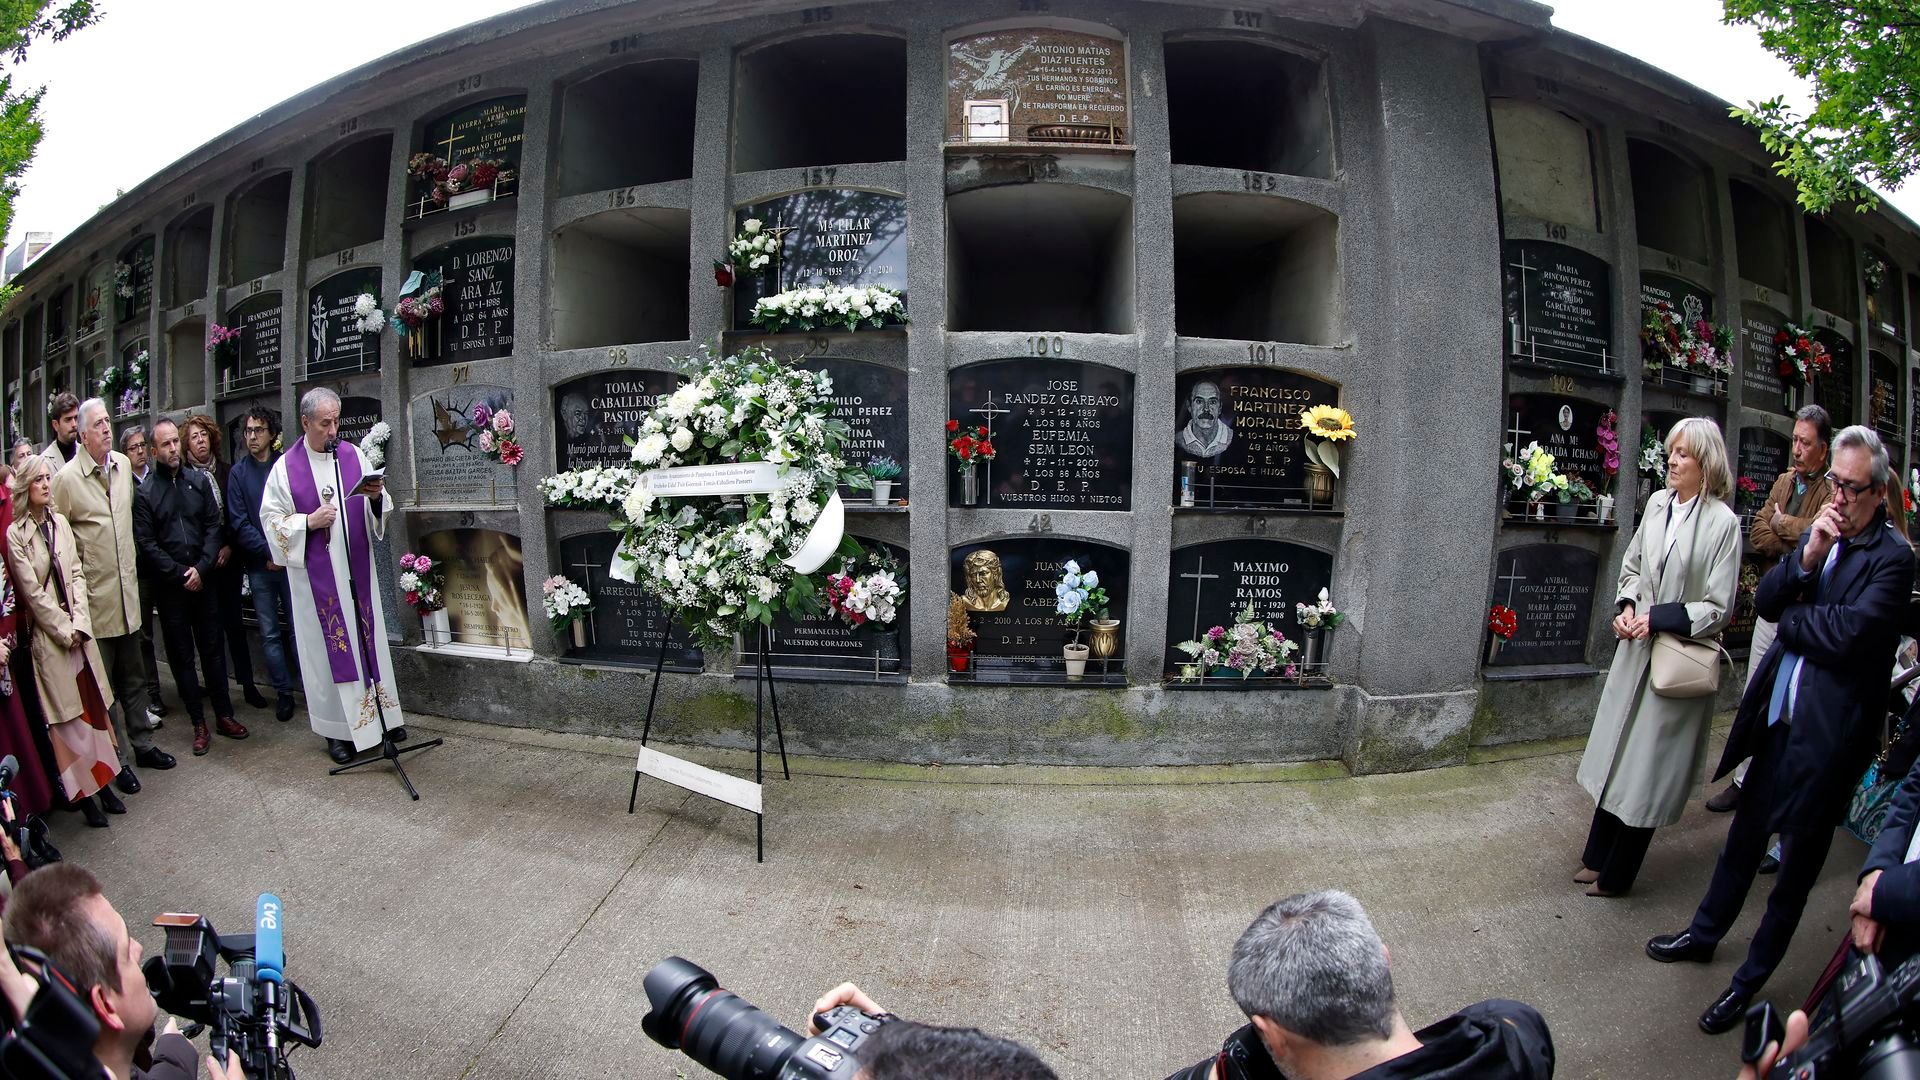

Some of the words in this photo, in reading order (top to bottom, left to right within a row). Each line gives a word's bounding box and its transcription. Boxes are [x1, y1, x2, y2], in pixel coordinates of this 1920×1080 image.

[1035, 45, 1075, 54] ANTONIO
[1077, 46, 1111, 55] MATIAS
[1041, 56, 1062, 64] DIAZ
[1064, 57, 1105, 66] FUENTES
[1042, 75, 1078, 83] HERMANOS
[483, 105, 505, 115] MARIA
[1090, 104, 1125, 112] RECUERDO
[480, 131, 502, 142] LUCIO
[802, 168, 837, 186] 157
[1242, 171, 1277, 192] 159
[608, 189, 636, 208] 156
[455, 221, 476, 237] 155
[838, 217, 871, 230] PILAR
[1546, 224, 1567, 240] 160
[816, 233, 873, 248] MARTINEZ
[466, 246, 513, 267] LORENZO
[828, 249, 859, 262] OROZ
[468, 266, 495, 283] SANZ
[1555, 263, 1579, 276] MARIA
[462, 312, 474, 322] LOS
[491, 307, 509, 319] AÑOS
[450, 343, 458, 352] TU
[462, 338, 486, 350] ESPOSA
[1028, 336, 1063, 355] 100
[609, 348, 628, 365] 98
[1248, 344, 1276, 363] 101
[453, 365, 469, 385] 97
[605, 381, 645, 394] TOMAS
[1046, 380, 1078, 391] JOSE
[1230, 385, 1311, 401] FRANCISCO
[591, 395, 659, 410] CABALLERO
[829, 396, 863, 405] MILIO
[1005, 393, 1056, 404] RANDEZ
[1060, 395, 1119, 407] GARBAYO
[858, 406, 893, 416] PEREZ
[1233, 400, 1307, 415] MARTINEZ
[339, 415, 356, 426] OISES
[1076, 418, 1101, 429] AÑOS
[1236, 416, 1302, 430] MORALES
[338, 429, 369, 440] FERNANDE
[1032, 430, 1090, 442] EUFEMIA
[1550, 433, 1565, 444] ANA
[587, 445, 598, 457] por
[600, 442, 607, 453] lo
[607, 444, 620, 456] que
[841, 439, 885, 448] MARTIN
[1265, 441, 1289, 452] AÑOS
[1028, 444, 1055, 455] SEM
[1059, 444, 1095, 456] LEON
[1023, 470, 1030, 478] A
[1035, 470, 1054, 478] LOS
[1075, 468, 1100, 479] AÑOS
[1209, 465, 1246, 475] ESPOSA
[1250, 466, 1257, 475] E
[1260, 467, 1286, 477] HIJOS
[1000, 493, 1046, 502] VUESTROS
[1050, 494, 1075, 503] HIJOS
[1080, 495, 1085, 503] Y
[1090, 495, 1123, 504] NIETOS
[1034, 561, 1063, 571] JUAN
[1233, 561, 1289, 573] MAXIMO
[1240, 575, 1280, 586] RUBIO
[599, 587, 643, 597] ARREGUI
[1236, 588, 1282, 598] RAMOS
[1519, 585, 1557, 593] GONZALEZ
[1559, 585, 1590, 594] IGLESIAS
[626, 609, 642, 617] LOS
[1015, 617, 1021, 625] A
[1025, 617, 1042, 625] LOS
[794, 627, 839, 636] PERMANECES
[841, 628, 851, 636] EN
[621, 639, 642, 647] HIJOS
[655, 641, 683, 650] NITOS
[783, 639, 819, 647] NUESTROS
[820, 639, 863, 648] CORAZONES
[260, 901, 278, 930] tve
